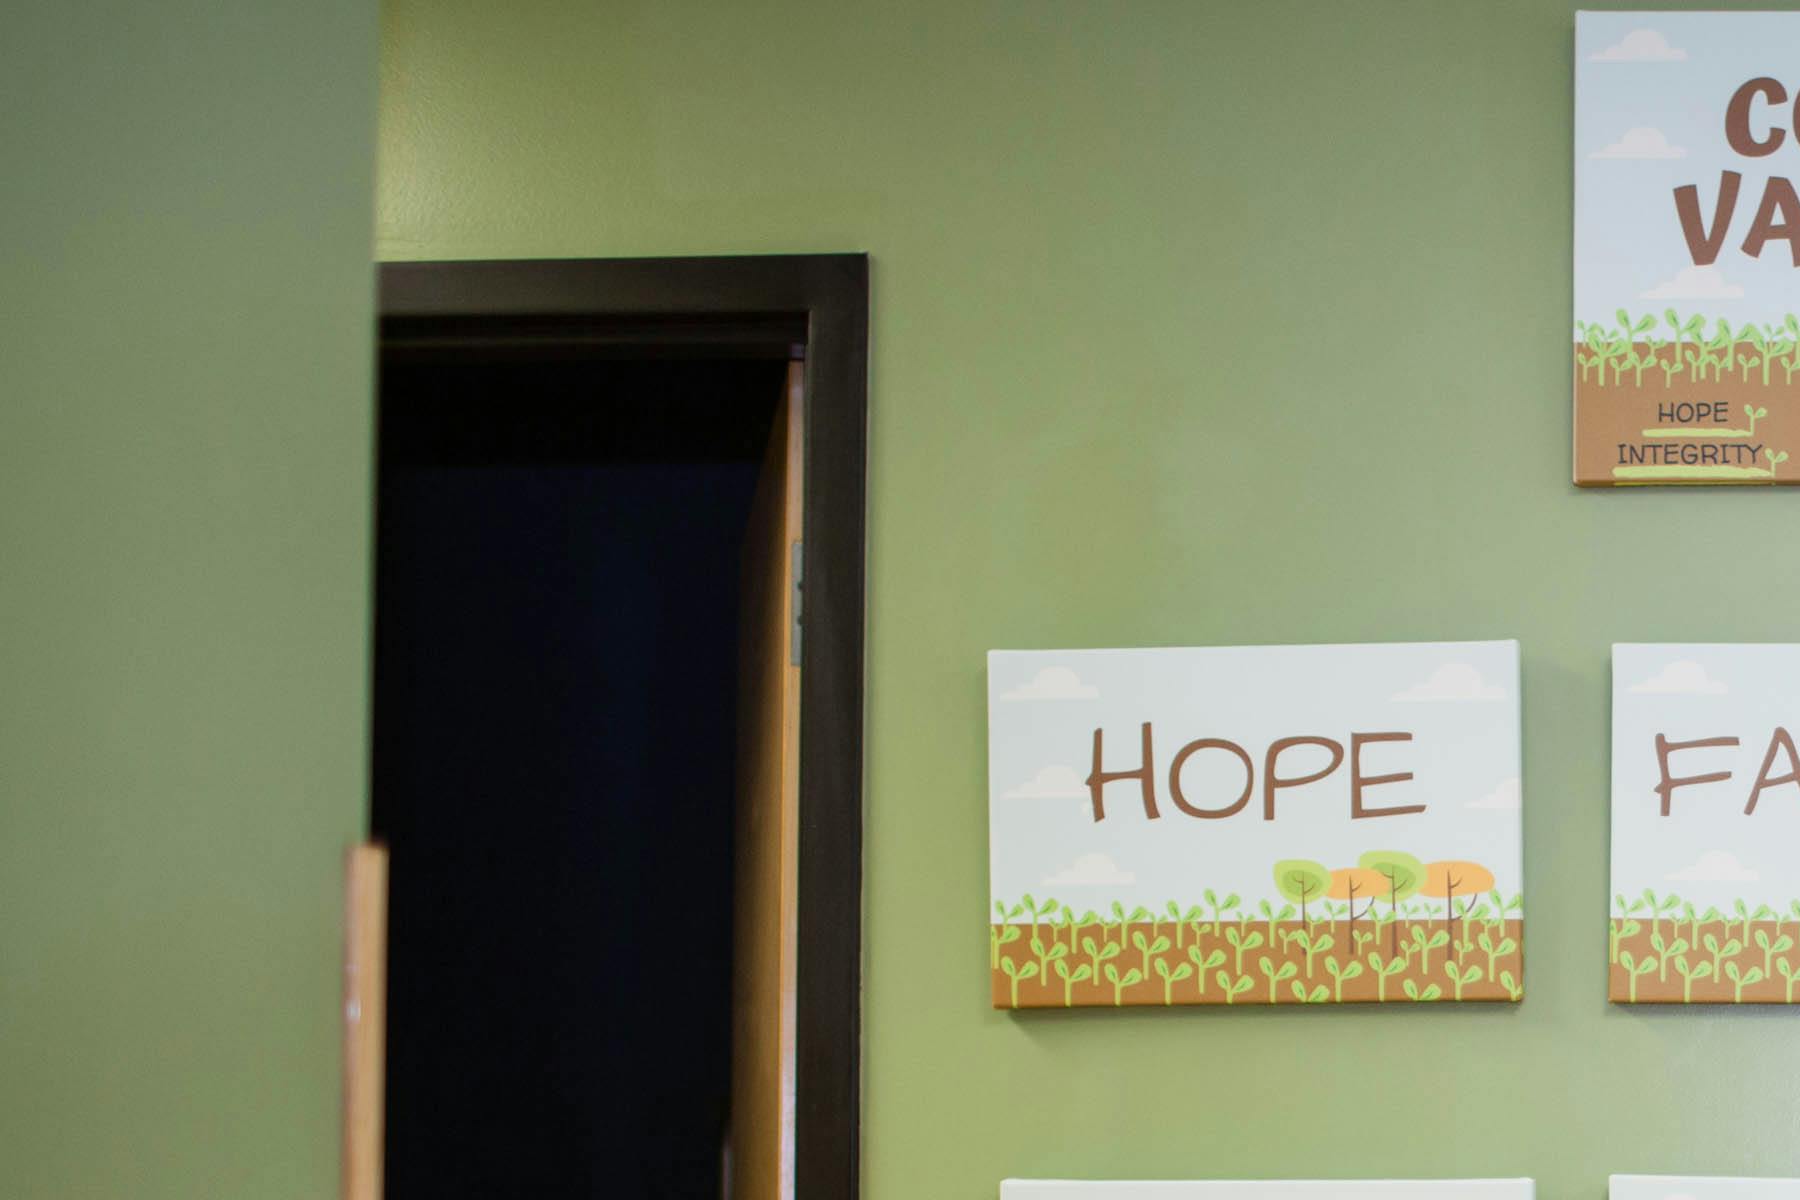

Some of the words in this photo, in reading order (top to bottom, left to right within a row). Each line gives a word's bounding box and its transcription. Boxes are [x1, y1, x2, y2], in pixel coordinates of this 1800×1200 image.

[1657, 401, 1729, 424] HOPE
[1617, 443, 1763, 465] INTEGRITY
[1084, 721, 1427, 823] HOPE
